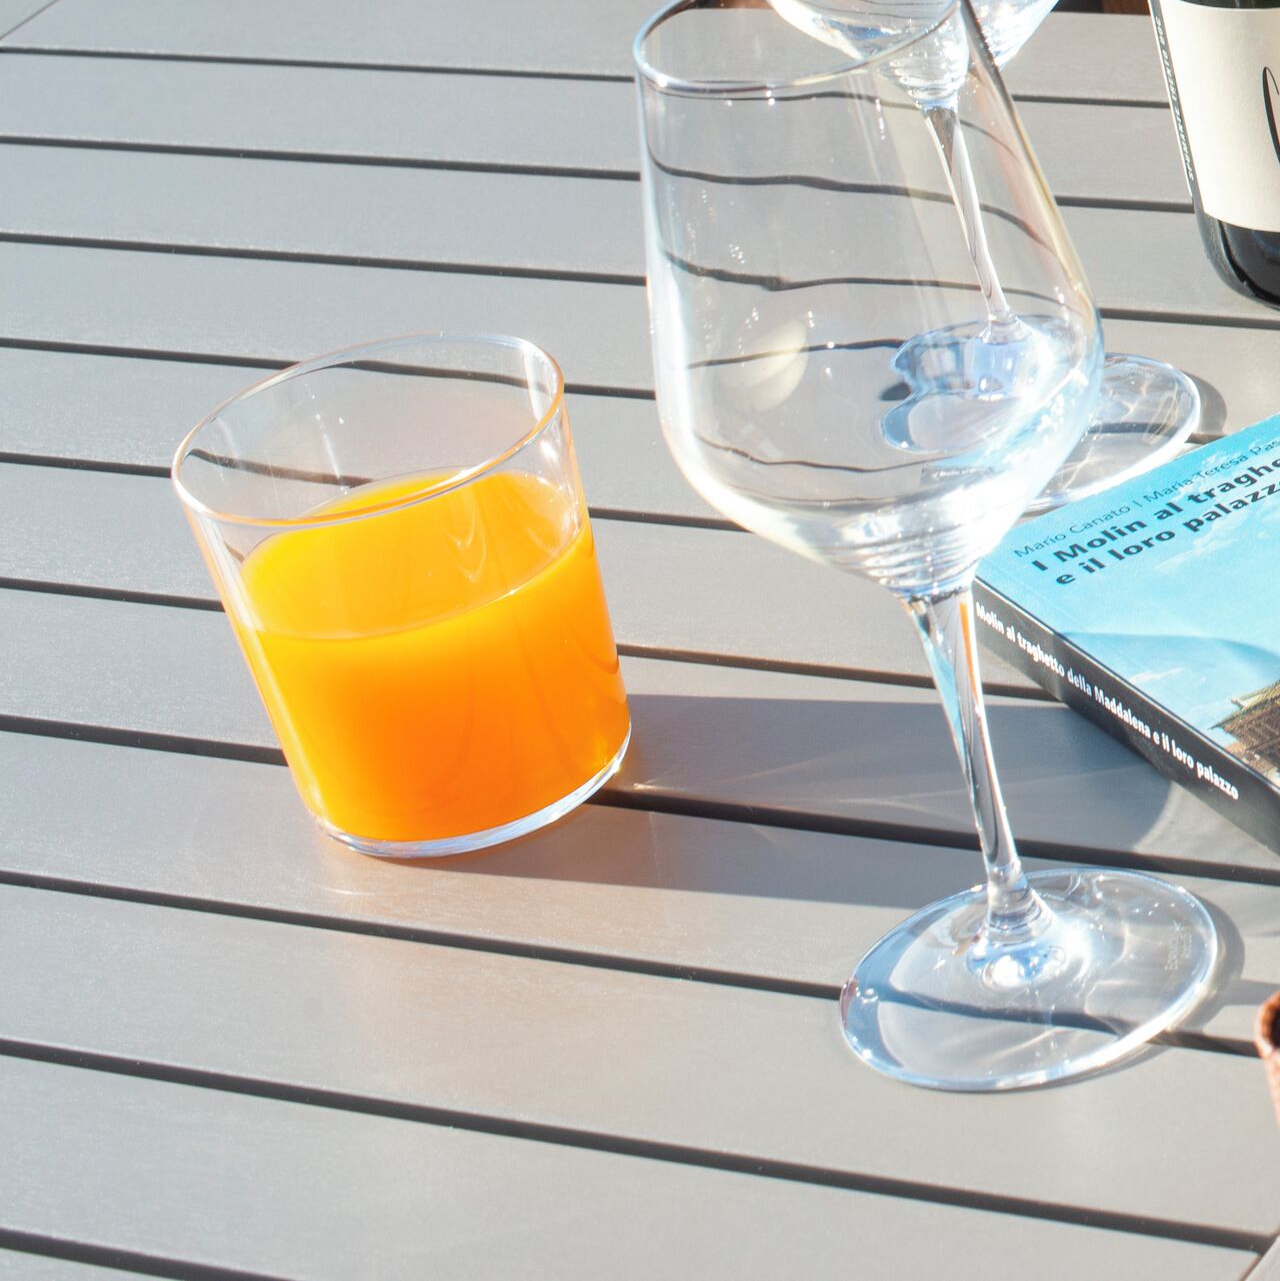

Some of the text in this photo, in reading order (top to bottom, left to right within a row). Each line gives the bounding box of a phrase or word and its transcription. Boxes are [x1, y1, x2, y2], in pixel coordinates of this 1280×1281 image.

[1014, 533, 1067, 558] Mario
[1069, 505, 1131, 534] Canato
[1143, 477, 1193, 503] Maria
[1194, 454, 1248, 481] Teresa
[1032, 560, 1049, 572] I
[1053, 520, 1147, 563] Molin
[1153, 501, 1184, 520] al
[1056, 573, 1076, 585] e
[1078, 557, 1106, 574] il
[1108, 530, 1176, 561] loro
[975, 601, 1240, 801] Molin al traghetto della Maddalena e il loro palazzo
